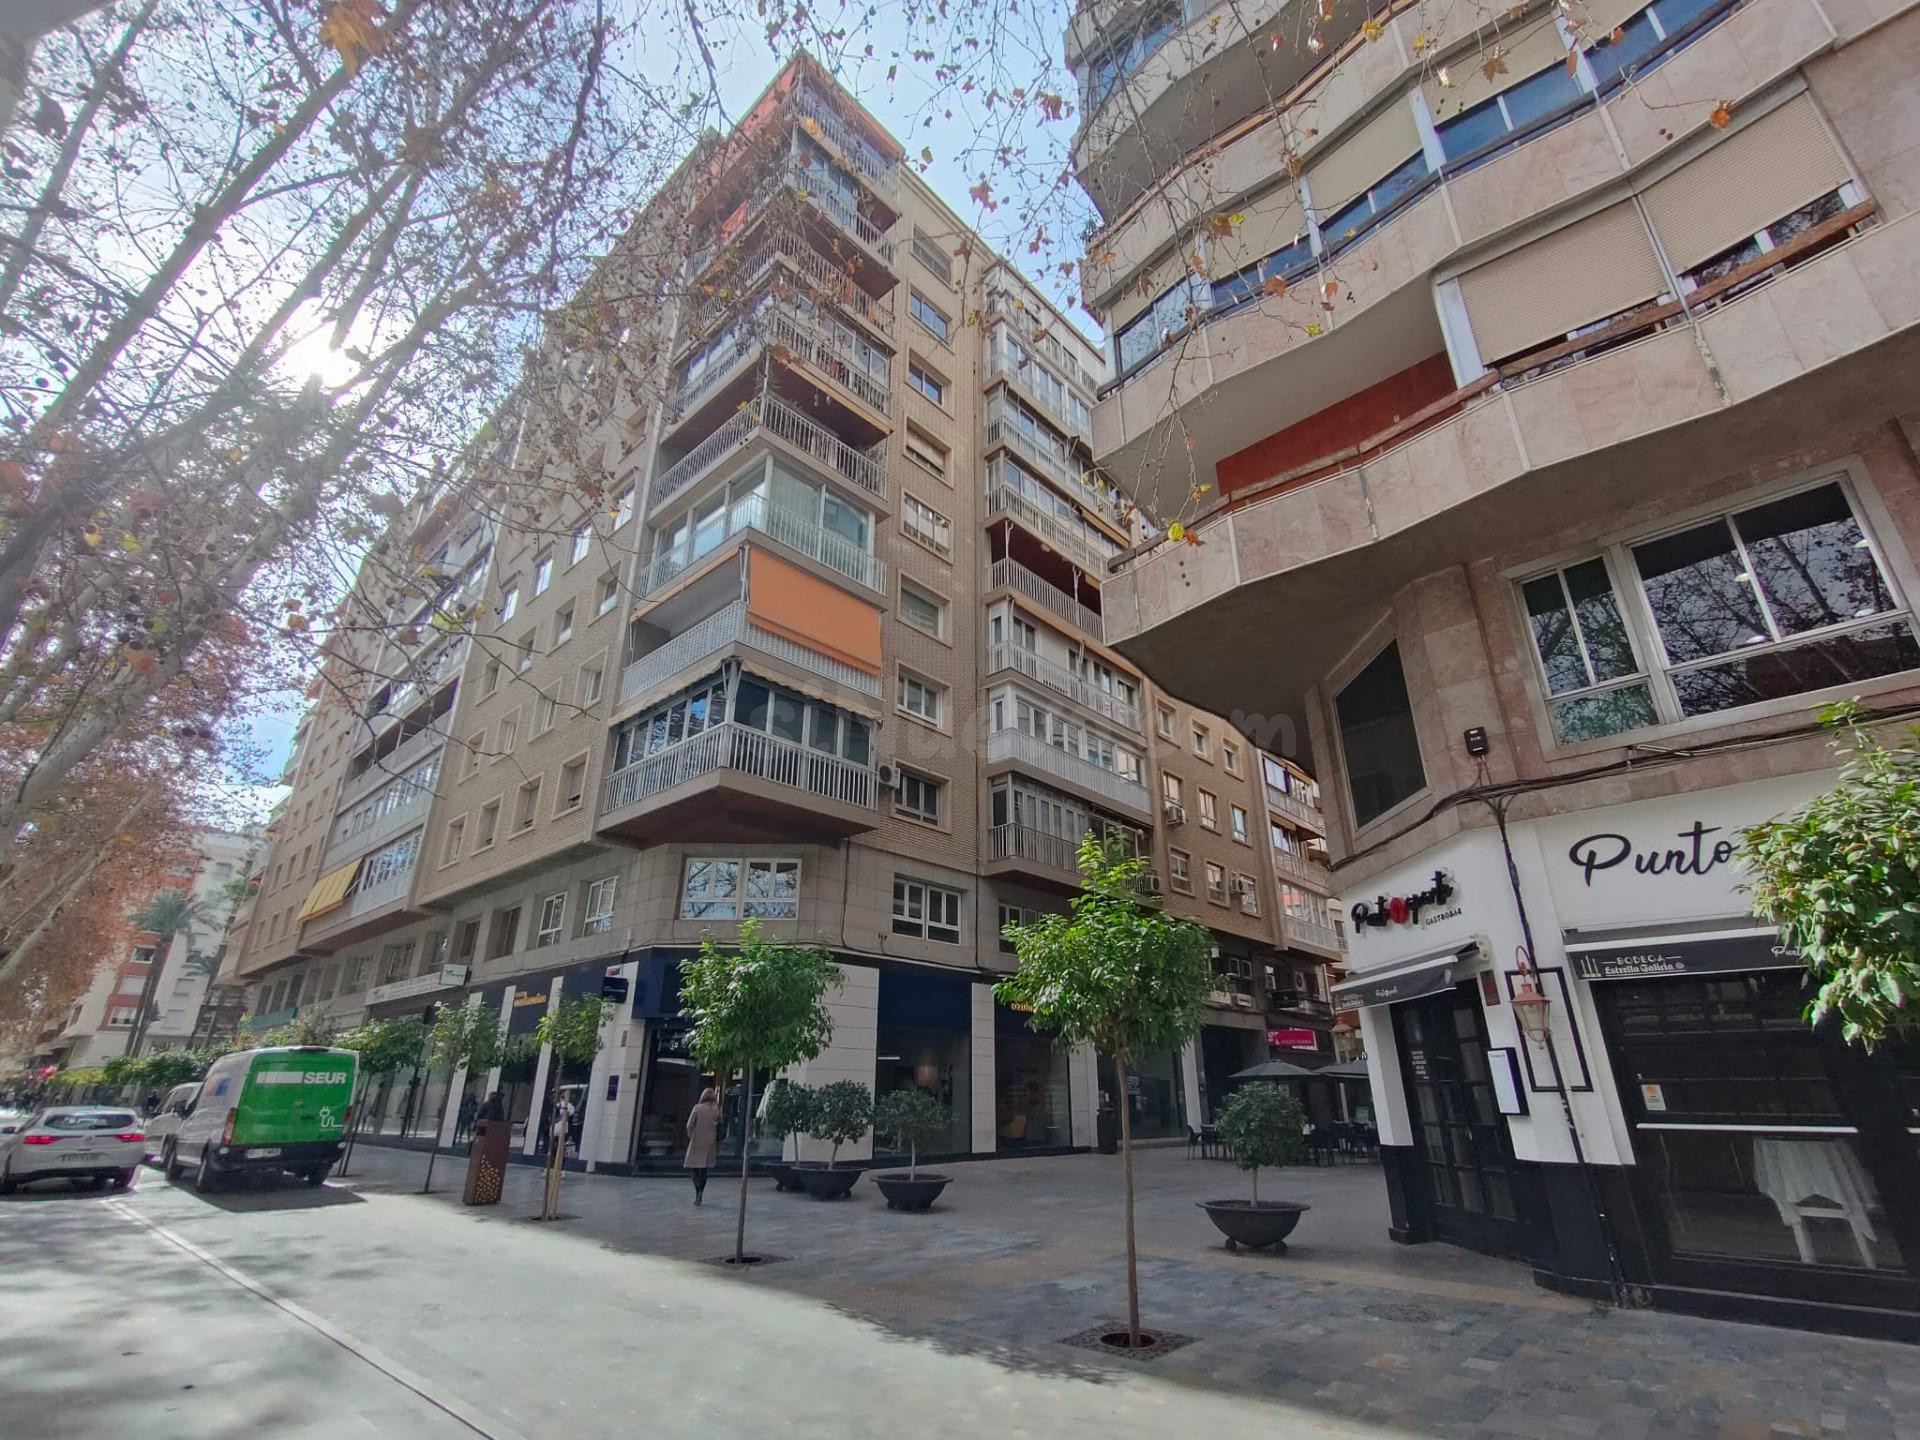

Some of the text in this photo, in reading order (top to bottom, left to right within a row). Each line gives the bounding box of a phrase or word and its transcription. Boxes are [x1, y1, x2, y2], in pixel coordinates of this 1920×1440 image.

[1569, 821, 1741, 887] Punto
[1771, 945, 1802, 958] Punt
[1605, 961, 1675, 975] Estrella Galicia
[303, 1071, 347, 1085] SEUR
